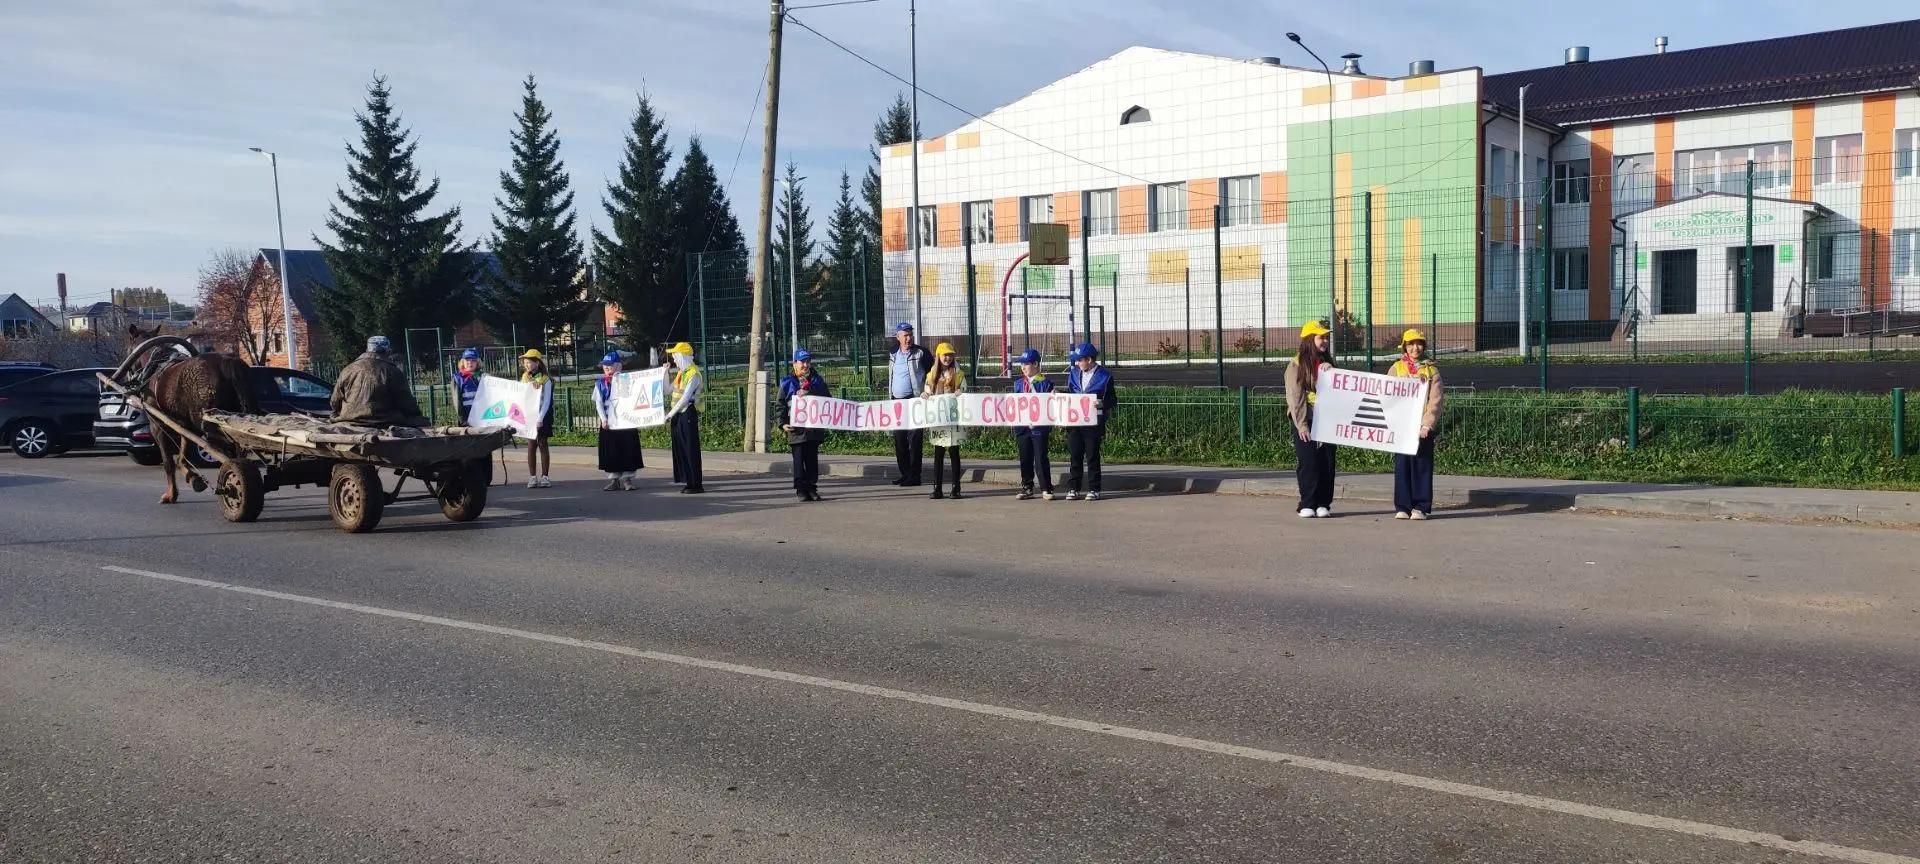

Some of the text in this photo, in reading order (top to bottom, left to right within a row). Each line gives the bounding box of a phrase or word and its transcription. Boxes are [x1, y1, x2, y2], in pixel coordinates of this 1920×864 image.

[794, 396, 1091, 428] ВОДИТЕЛЬ! СБАВЬ СКОРОСТЬ!
[1335, 424, 1395, 444] ПЕРЕХОД
